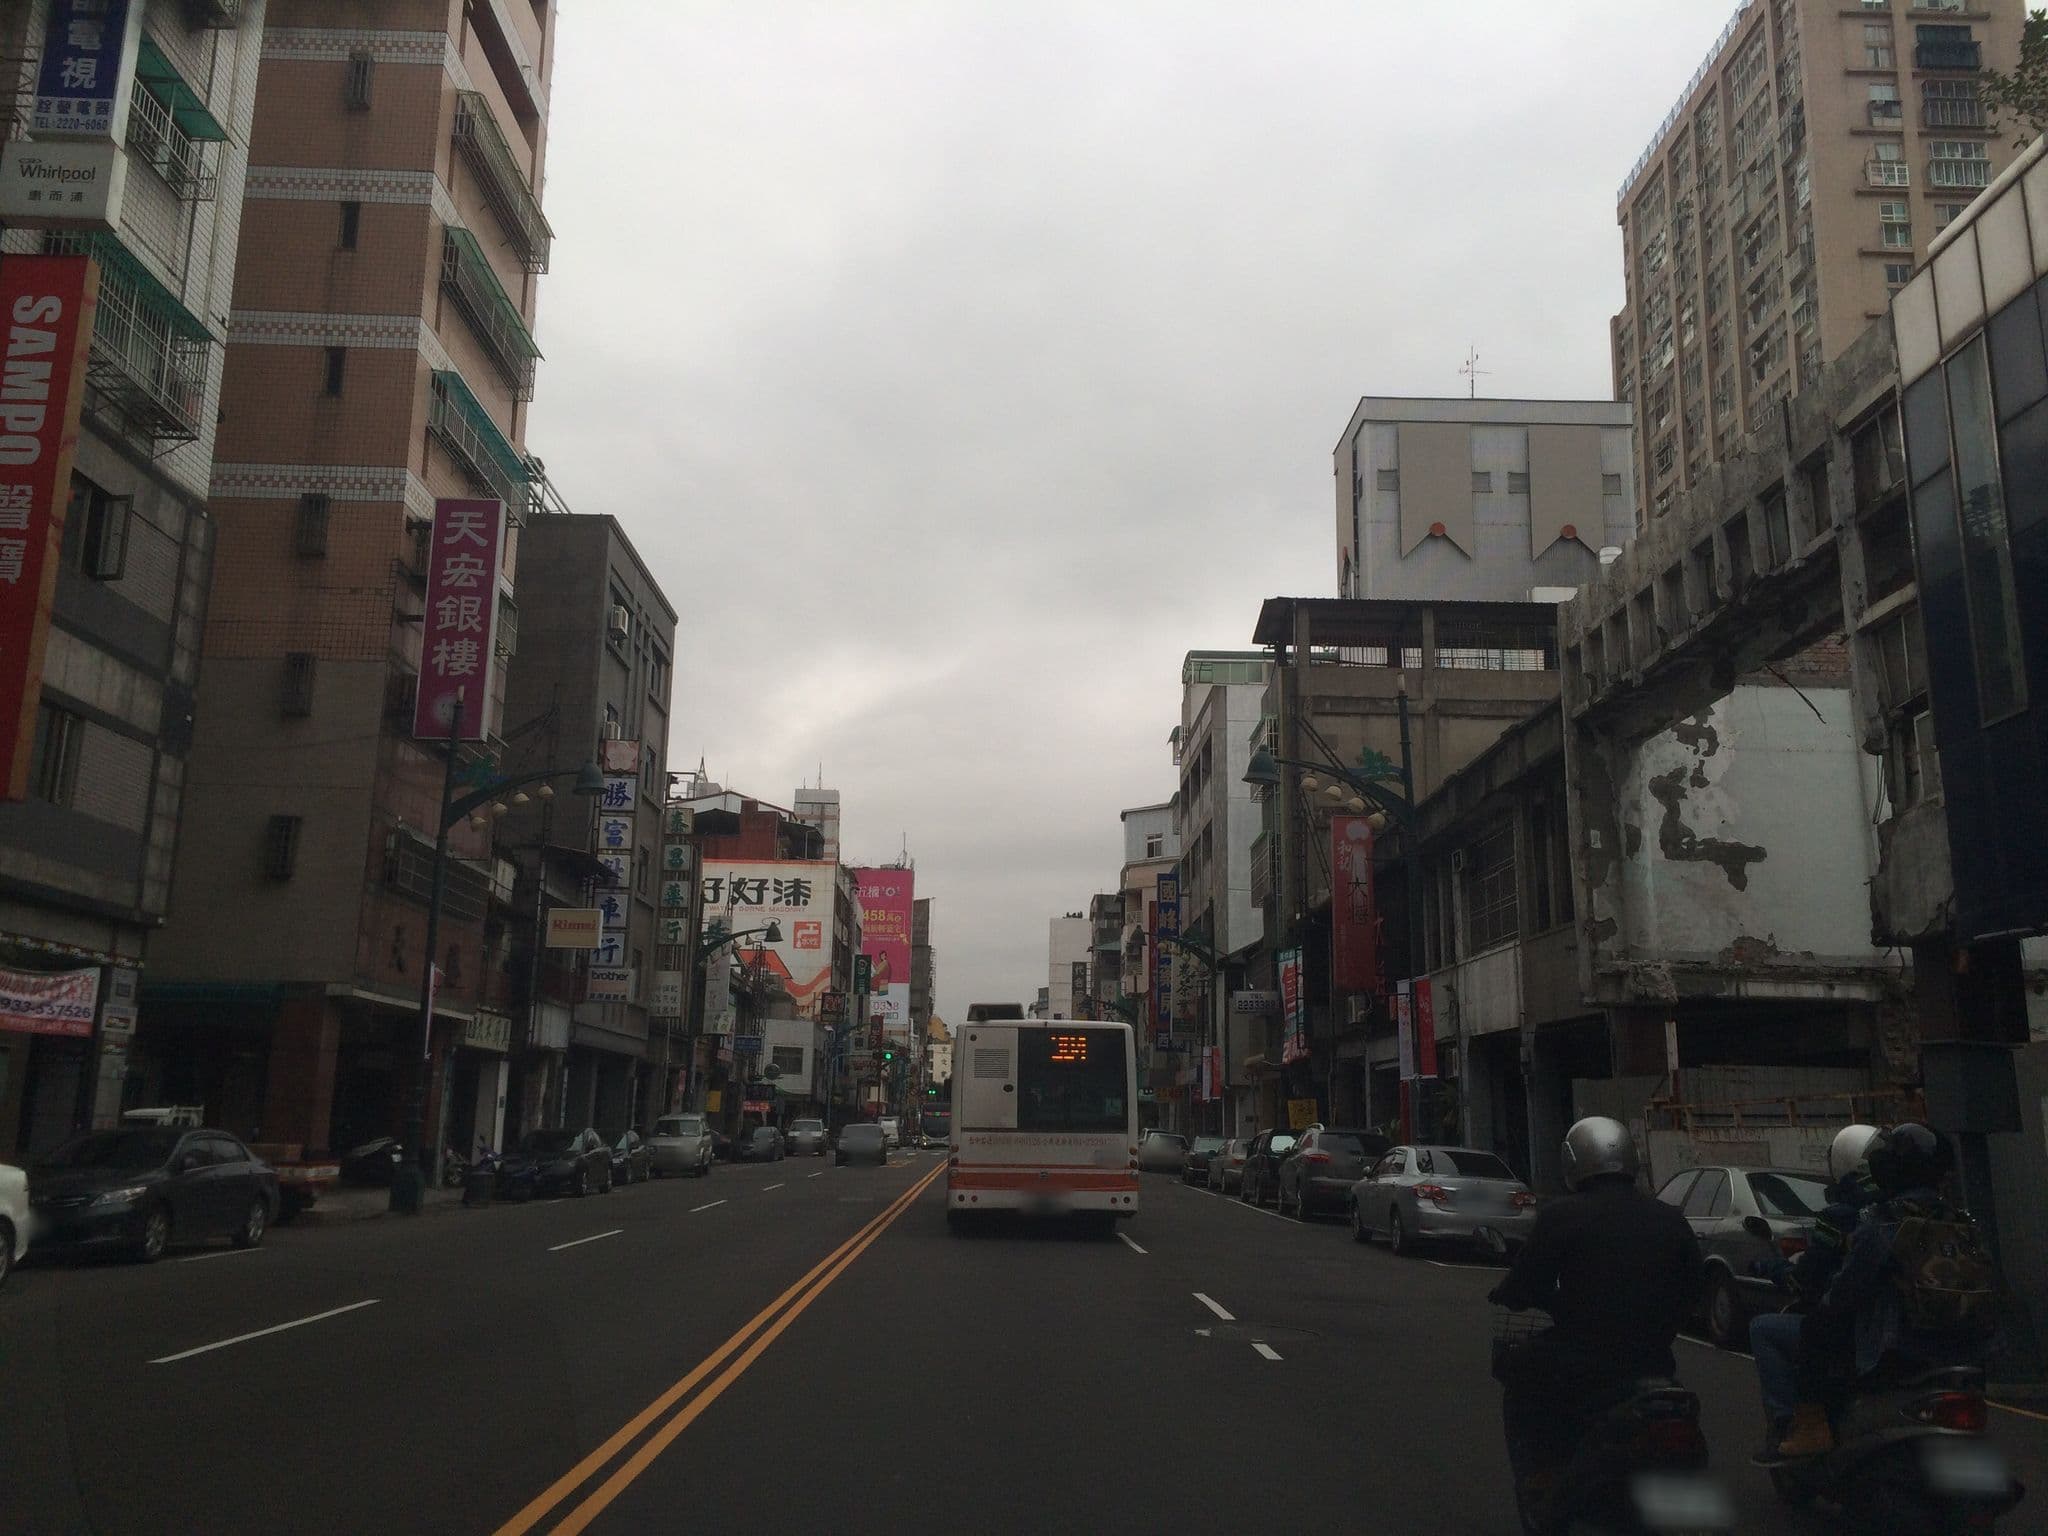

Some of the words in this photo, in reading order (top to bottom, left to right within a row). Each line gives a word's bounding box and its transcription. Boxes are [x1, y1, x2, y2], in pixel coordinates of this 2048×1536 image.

[20, 164, 96, 184] Whirlpool
[0, 295, 63, 466] SAMPO
[431, 511, 489, 678] 天宏銀樓
[592, 970, 629, 981] brother
